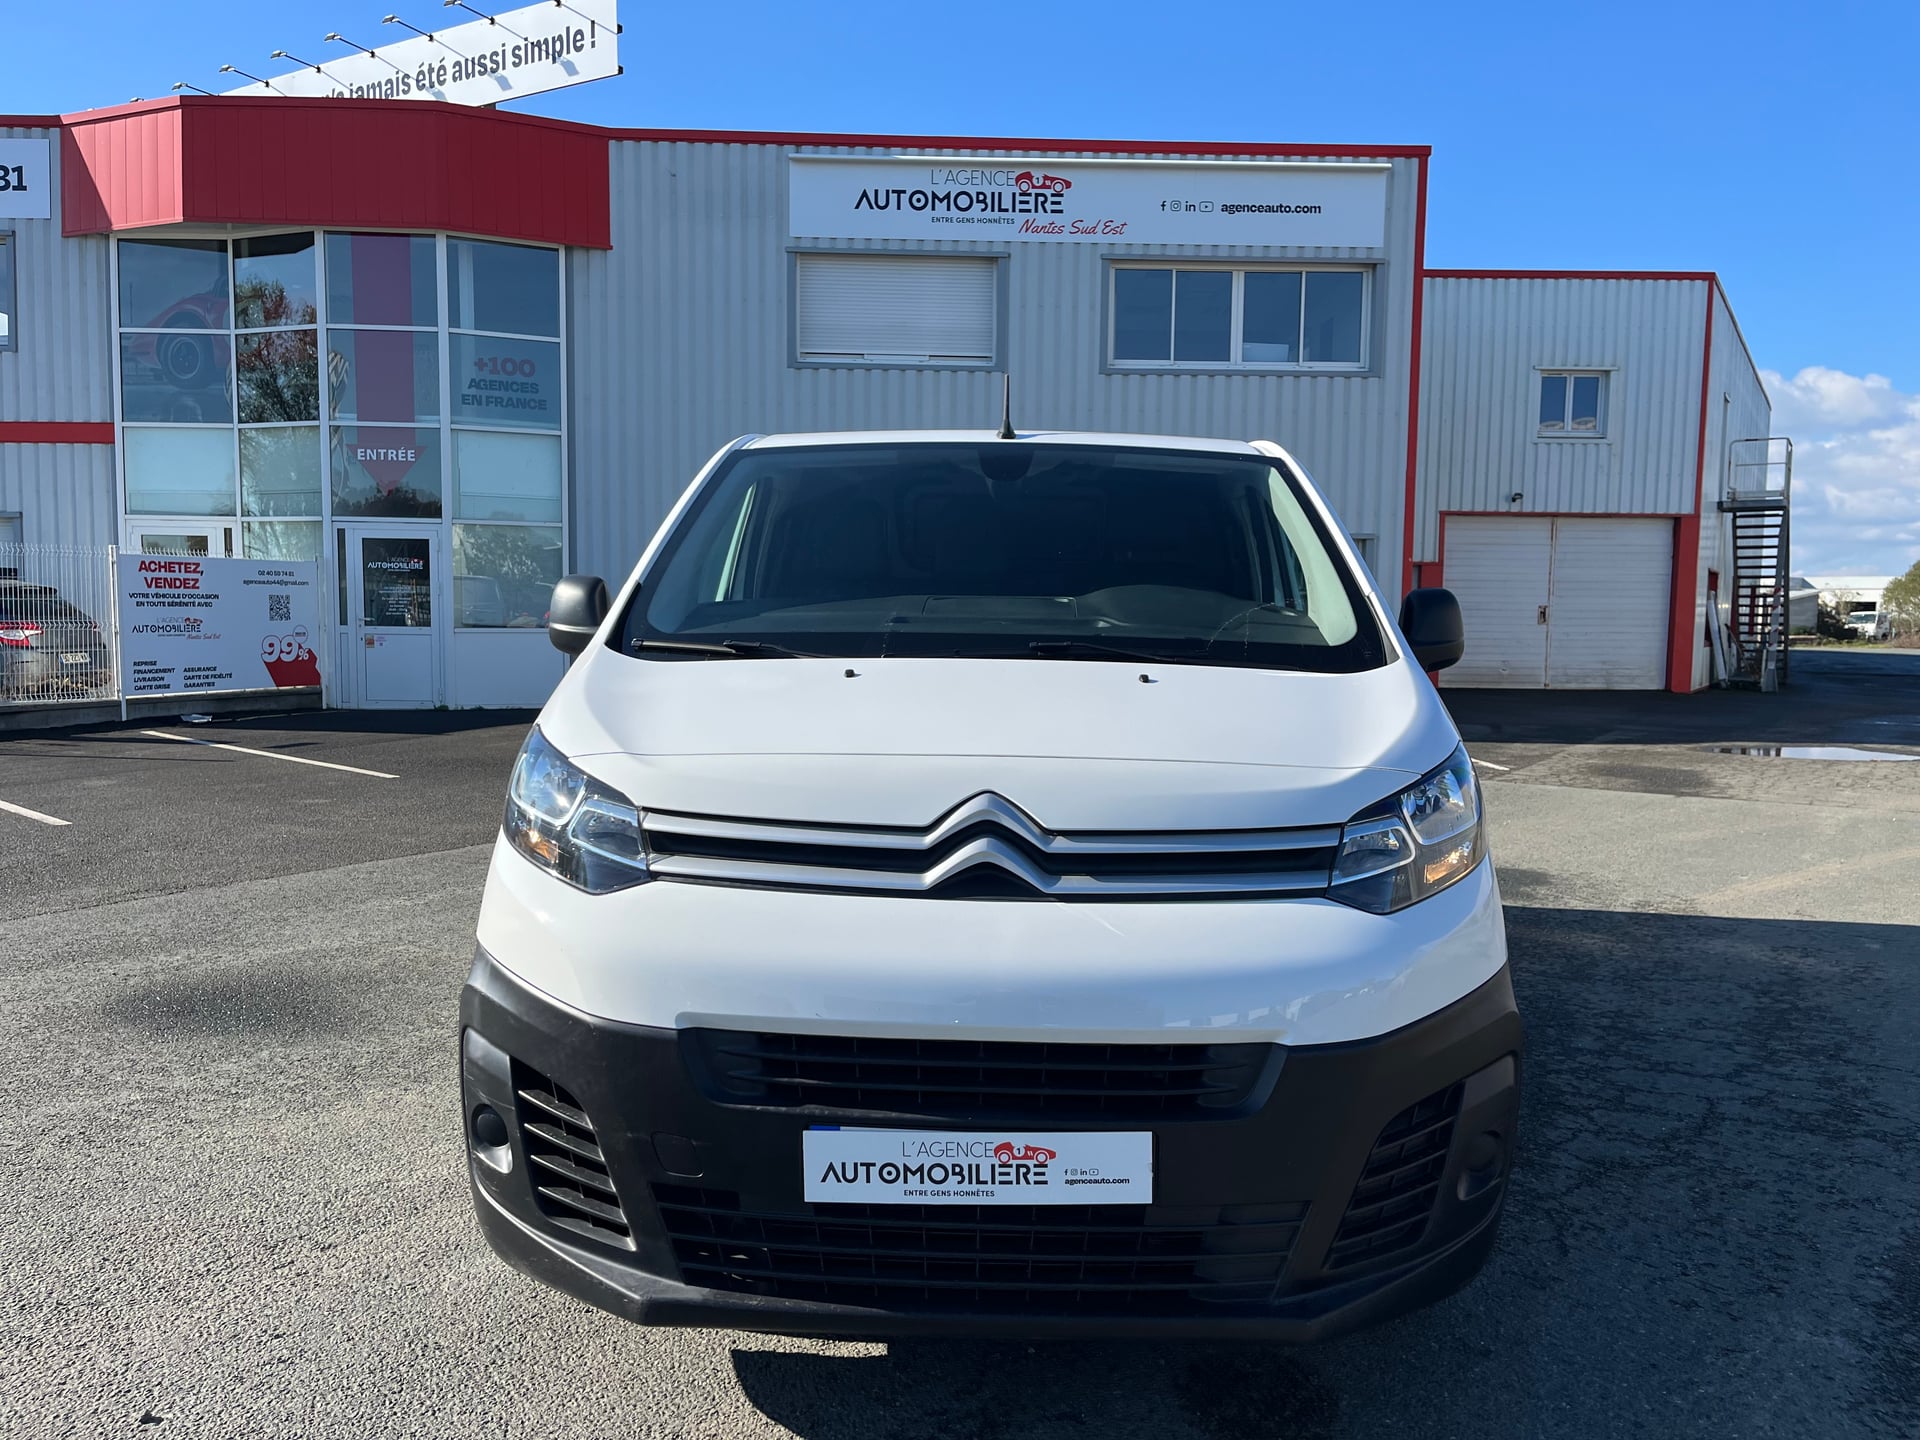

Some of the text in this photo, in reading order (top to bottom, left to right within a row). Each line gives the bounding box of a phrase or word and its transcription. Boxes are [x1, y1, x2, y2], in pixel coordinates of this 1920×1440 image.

[415, 59, 447, 91] été
[451, 42, 507, 82] aussi
[511, 25, 585, 67] simple
[931, 168, 1016, 187] L'AGENCE
[1221, 202, 1322, 215] agenceauto.com
[931, 216, 1016, 225] ENTRE GENS HONNÊTES
[1018, 219, 1129, 235] Nantes Sud Est
[474, 357, 536, 378] +100
[468, 378, 539, 393] AGENCES
[461, 394, 547, 411] EN FRANCE
[357, 447, 416, 462] ENTRÉE
[138, 560, 204, 576] ACHETEZ,
[144, 577, 200, 590] VENDEZ
[151, 591, 180, 600] VÉHICULE
[182, 592, 219, 600] D'OCCASION
[167, 600, 196, 608] SÉRÉNITÉ
[210, 672, 233, 680] FIDÉLITÉ
[184, 681, 215, 689] GARANTIES
[902, 1141, 995, 1158] L'AGENCE
[1064, 1178, 1130, 1186] agenceauto.com
[903, 1187, 995, 1198] ENTRE GENS HONNÊTES
